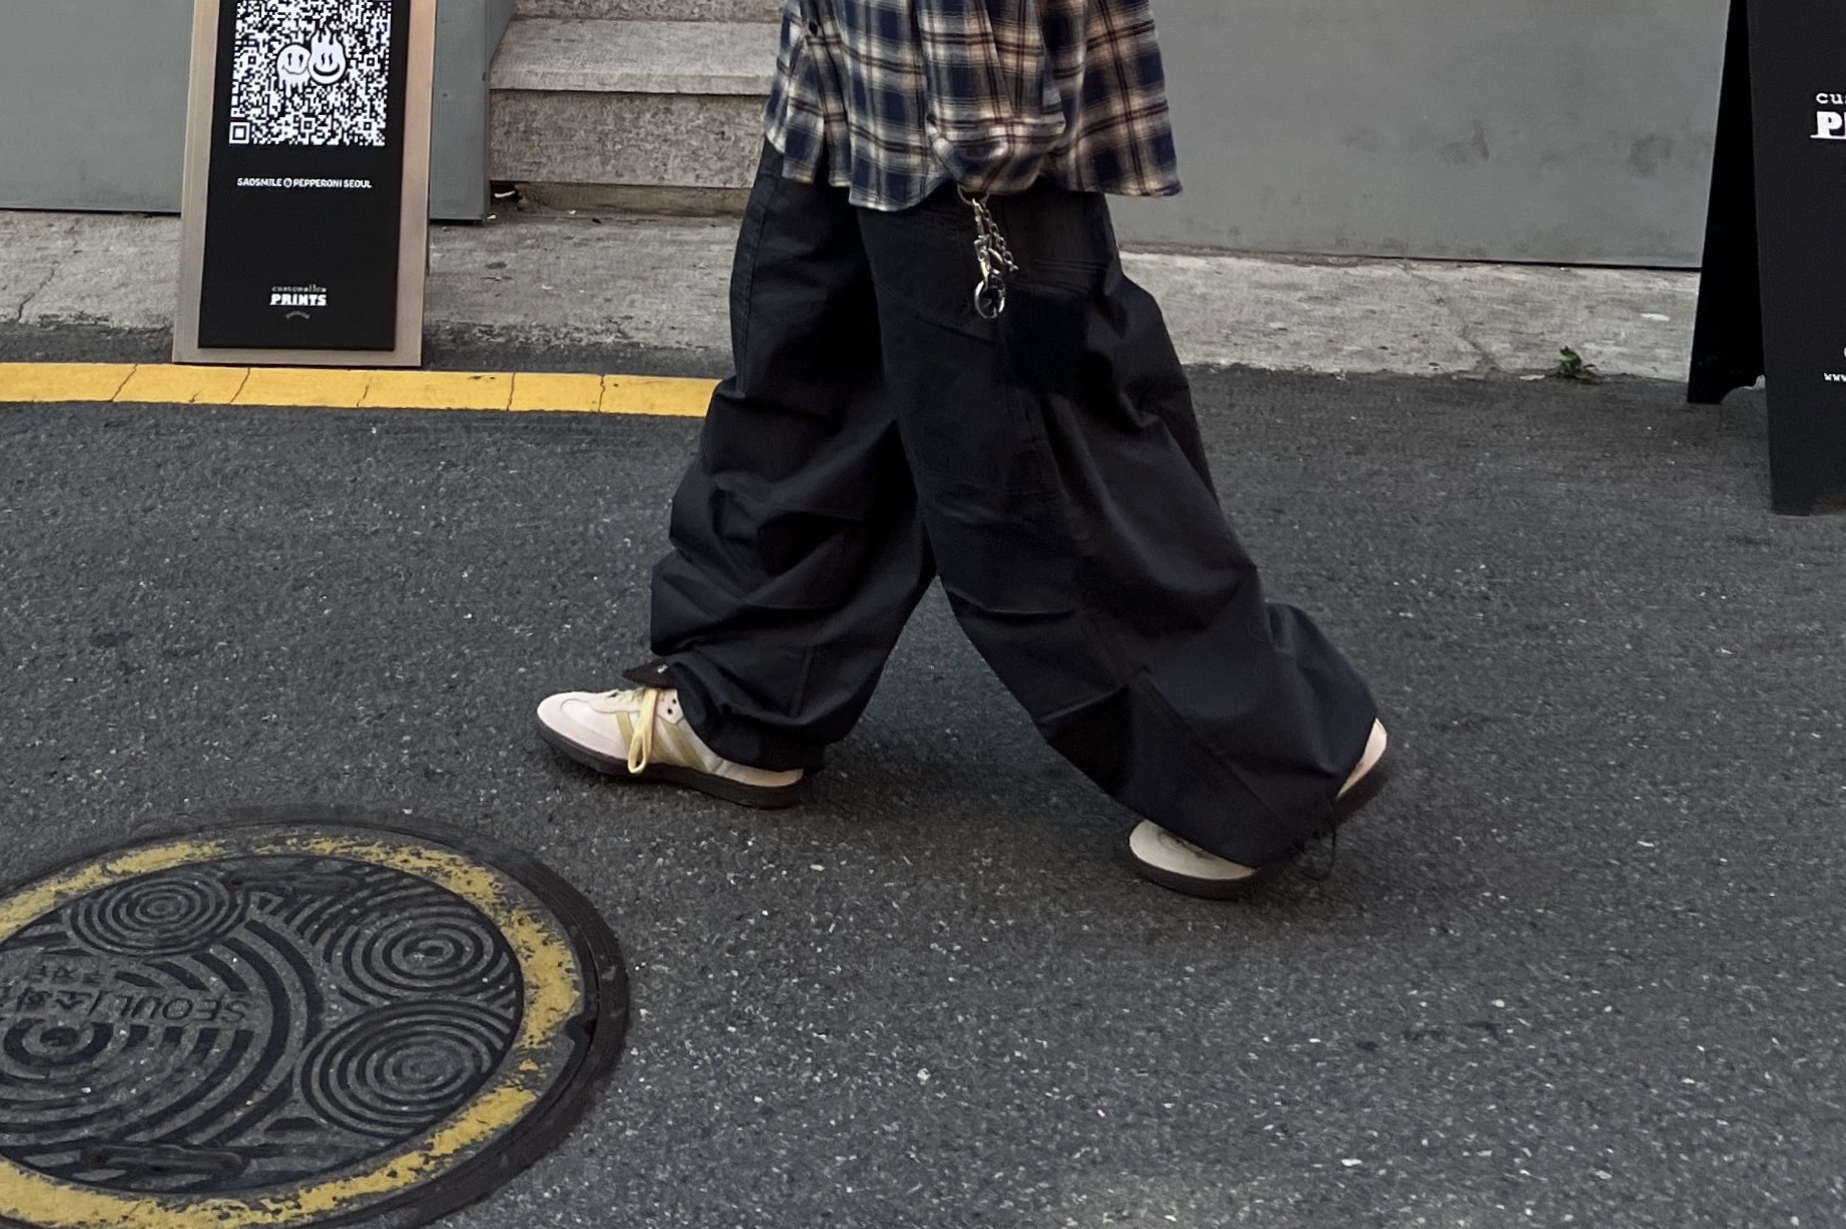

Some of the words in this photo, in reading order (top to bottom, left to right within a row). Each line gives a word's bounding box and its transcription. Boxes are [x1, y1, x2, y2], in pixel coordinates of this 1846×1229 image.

[1816, 92, 1846, 105] cu
[1810, 111, 1846, 140] P
[237, 177, 282, 187] SADSMILE
[292, 178, 342, 188] PEPPERONI
[343, 179, 372, 189] SEOUL
[269, 293, 328, 307] PRINTS
[114, 993, 250, 1023] SEOUL
